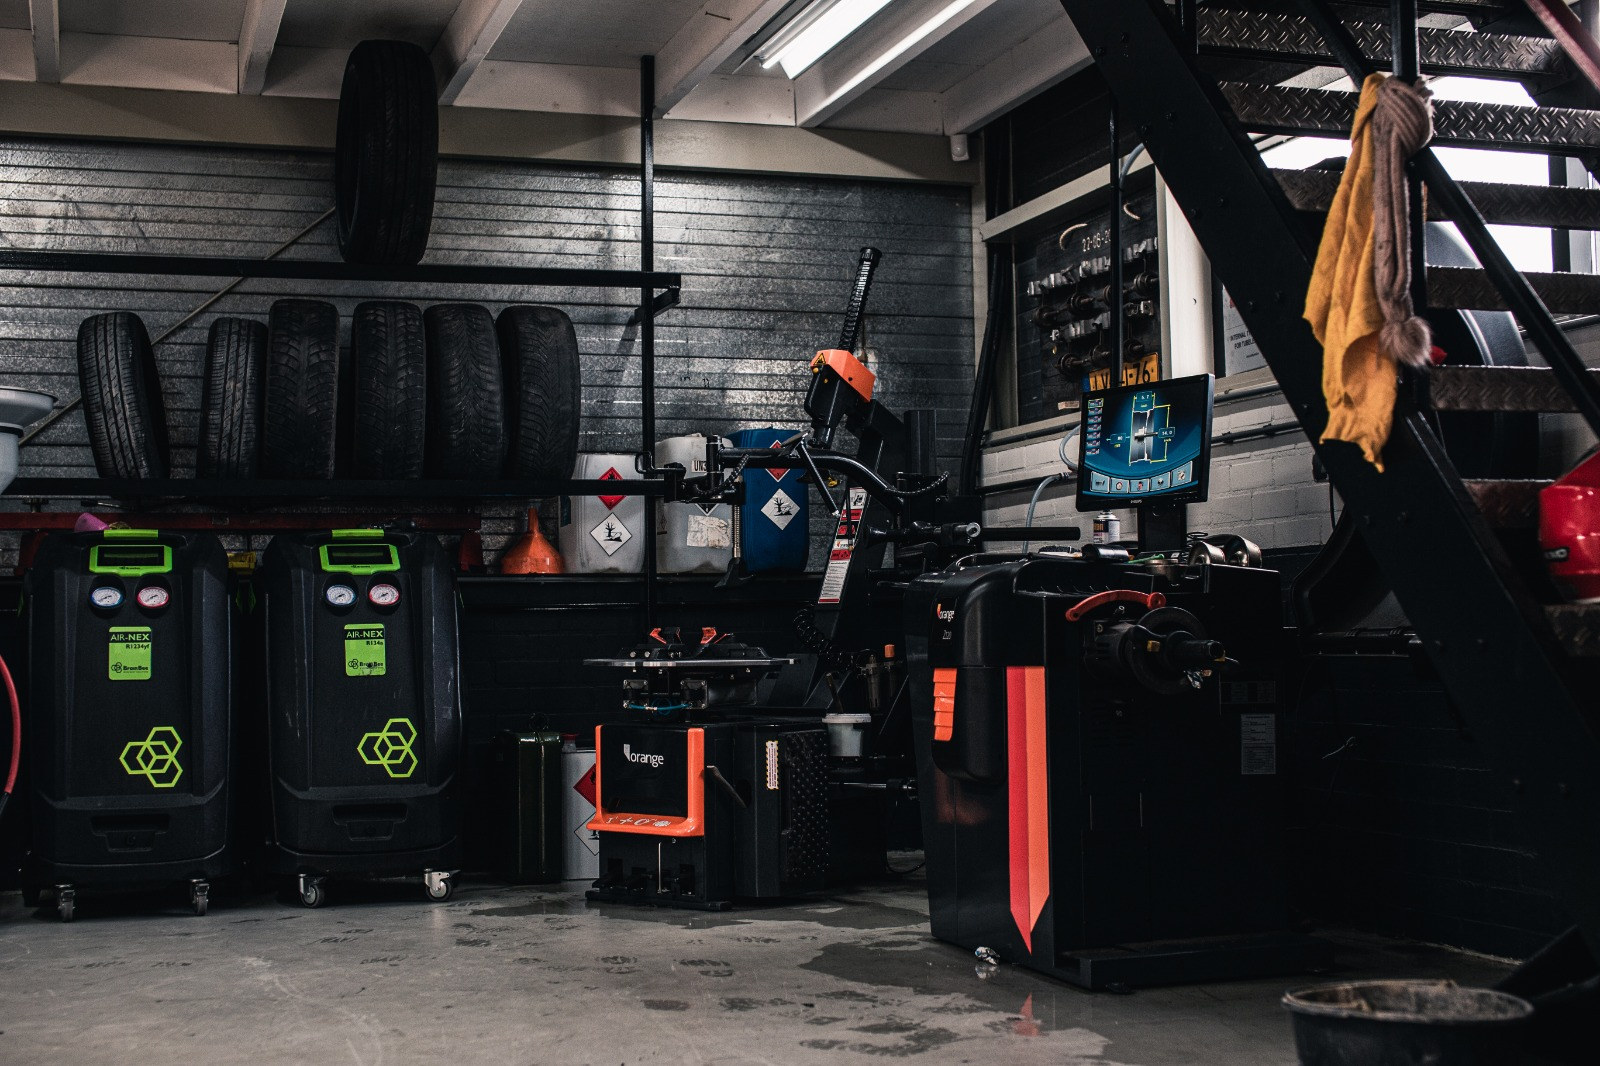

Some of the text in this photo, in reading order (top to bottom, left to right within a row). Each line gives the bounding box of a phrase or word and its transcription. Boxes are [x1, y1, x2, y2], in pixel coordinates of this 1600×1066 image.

[110, 633, 150, 641] AIR-NEX
[346, 630, 383, 639] AIR-NEX
[630, 752, 664, 768] orange
